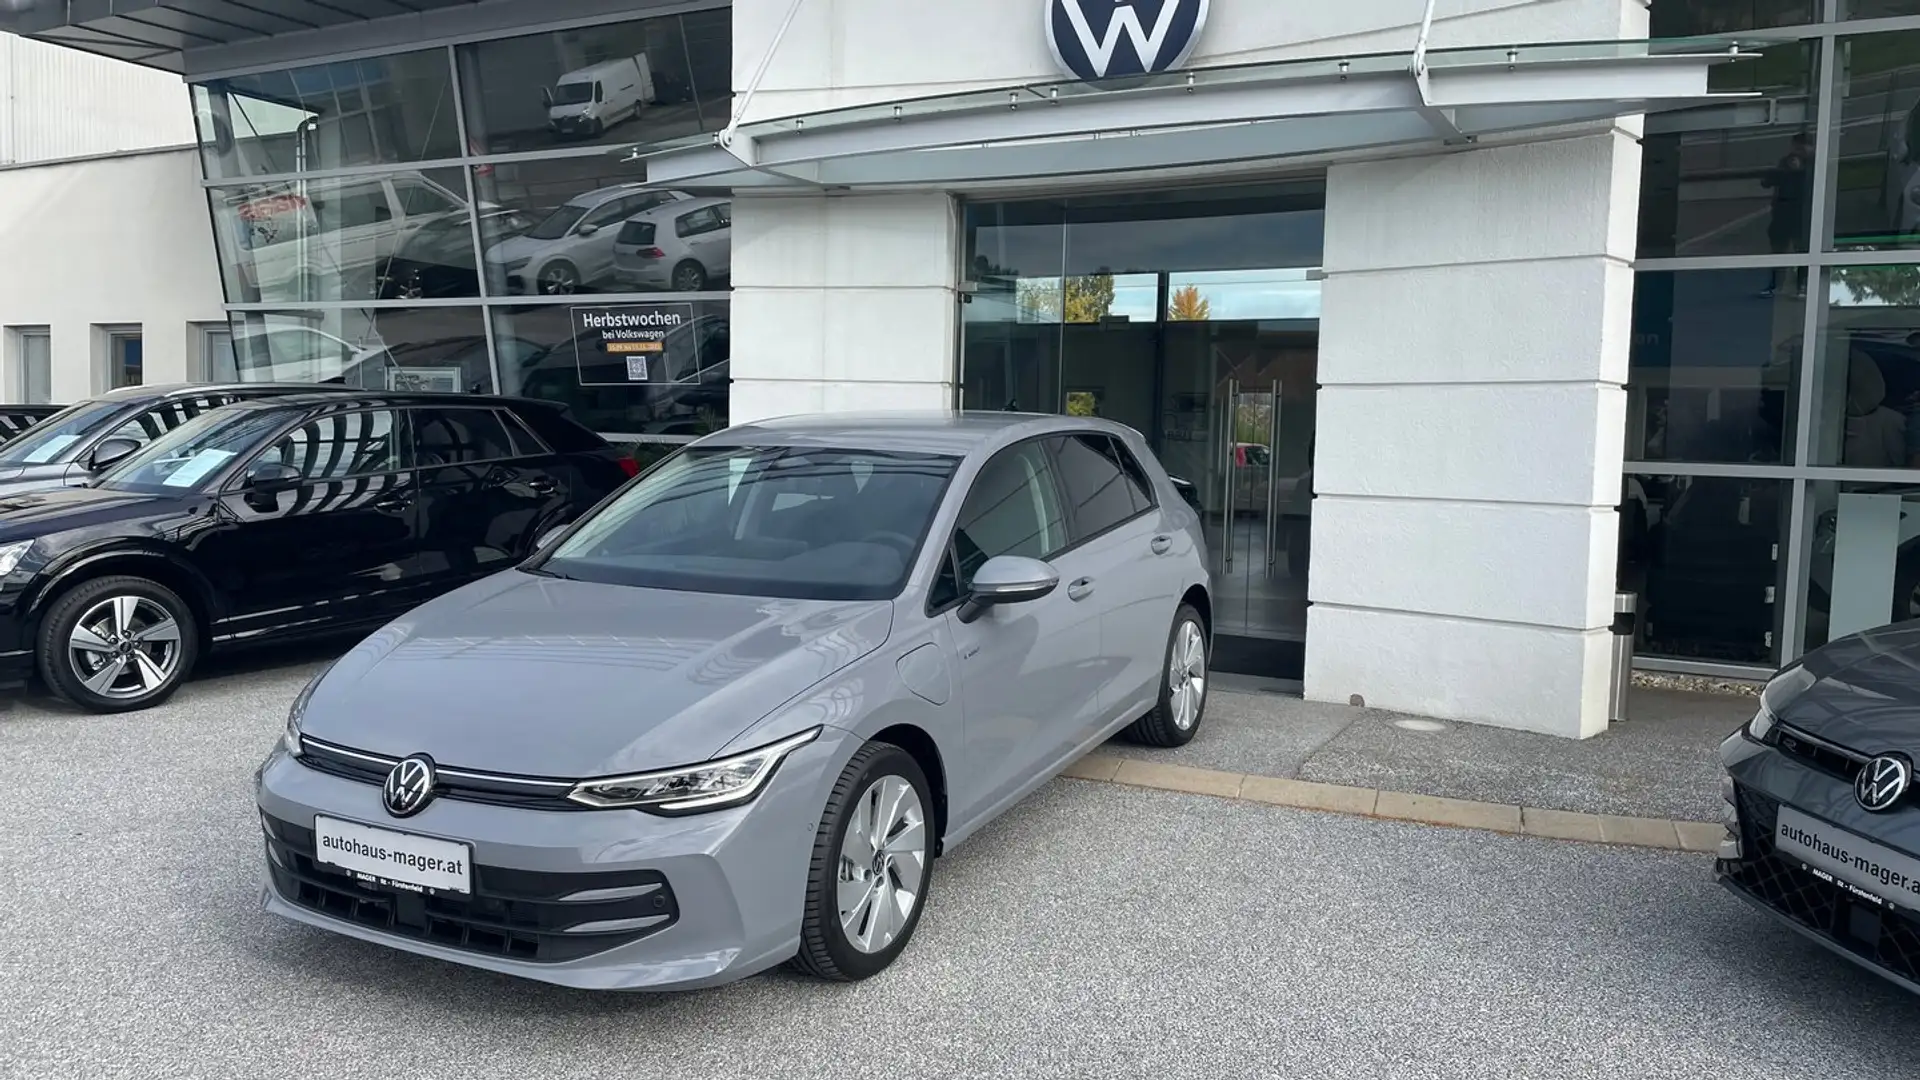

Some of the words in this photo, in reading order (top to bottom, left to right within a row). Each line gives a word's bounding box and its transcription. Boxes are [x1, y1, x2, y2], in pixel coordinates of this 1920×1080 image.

[1056, 0, 1182, 77] W
[582, 311, 681, 327] Herbstwochen
[602, 330, 615, 339] bei
[615, 329, 665, 340] Volkswagen
[322, 834, 463, 875] autohaus-mager.at
[357, 872, 376, 882] MAGER
